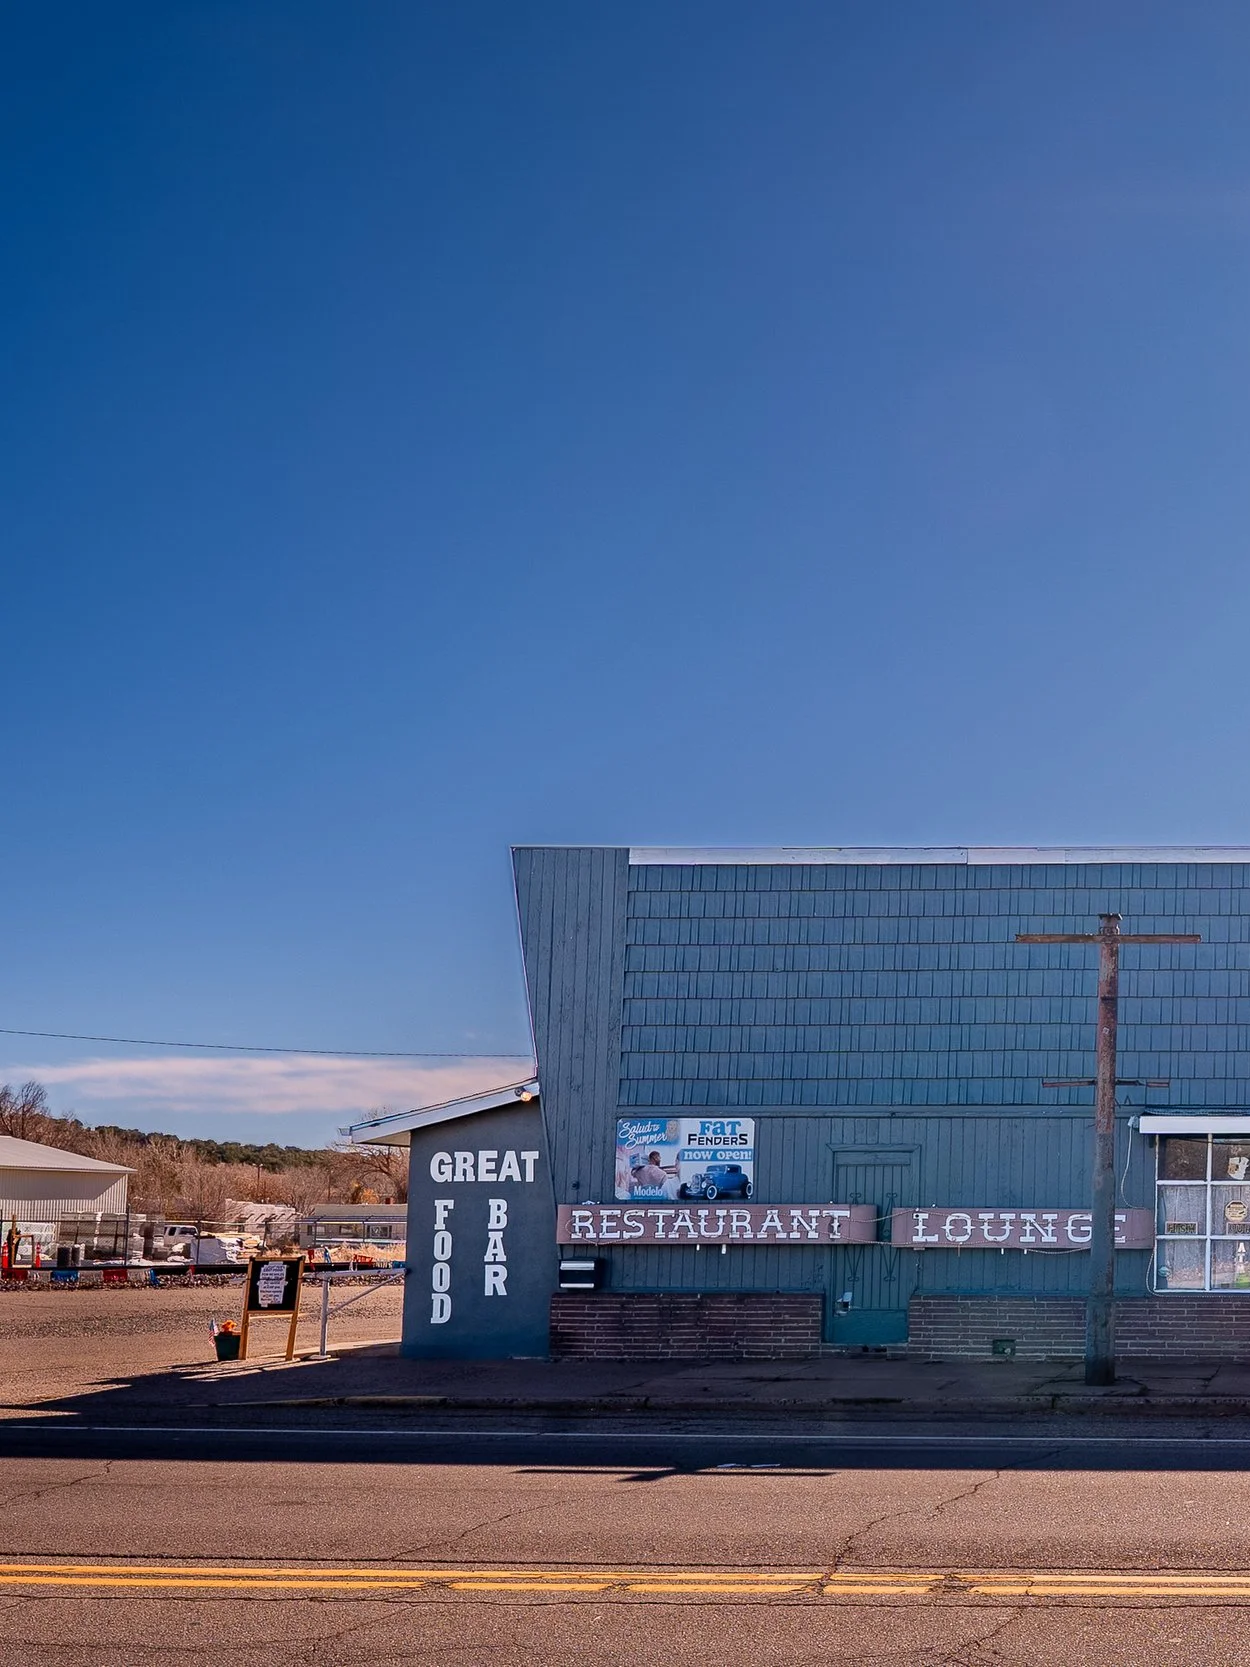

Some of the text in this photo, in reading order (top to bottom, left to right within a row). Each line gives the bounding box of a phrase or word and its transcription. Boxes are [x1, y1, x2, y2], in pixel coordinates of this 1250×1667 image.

[619, 1121, 651, 1139] Salud
[624, 1133, 668, 1149] Summer
[430, 1150, 539, 1183] GREAT
[633, 1185, 663, 1196] Modelo
[570, 1209, 850, 1239] RESTAURANT
[1167, 1223, 1196, 1234] FISH
[483, 1198, 508, 1297] BAR
[430, 1199, 455, 1325] FOOD
